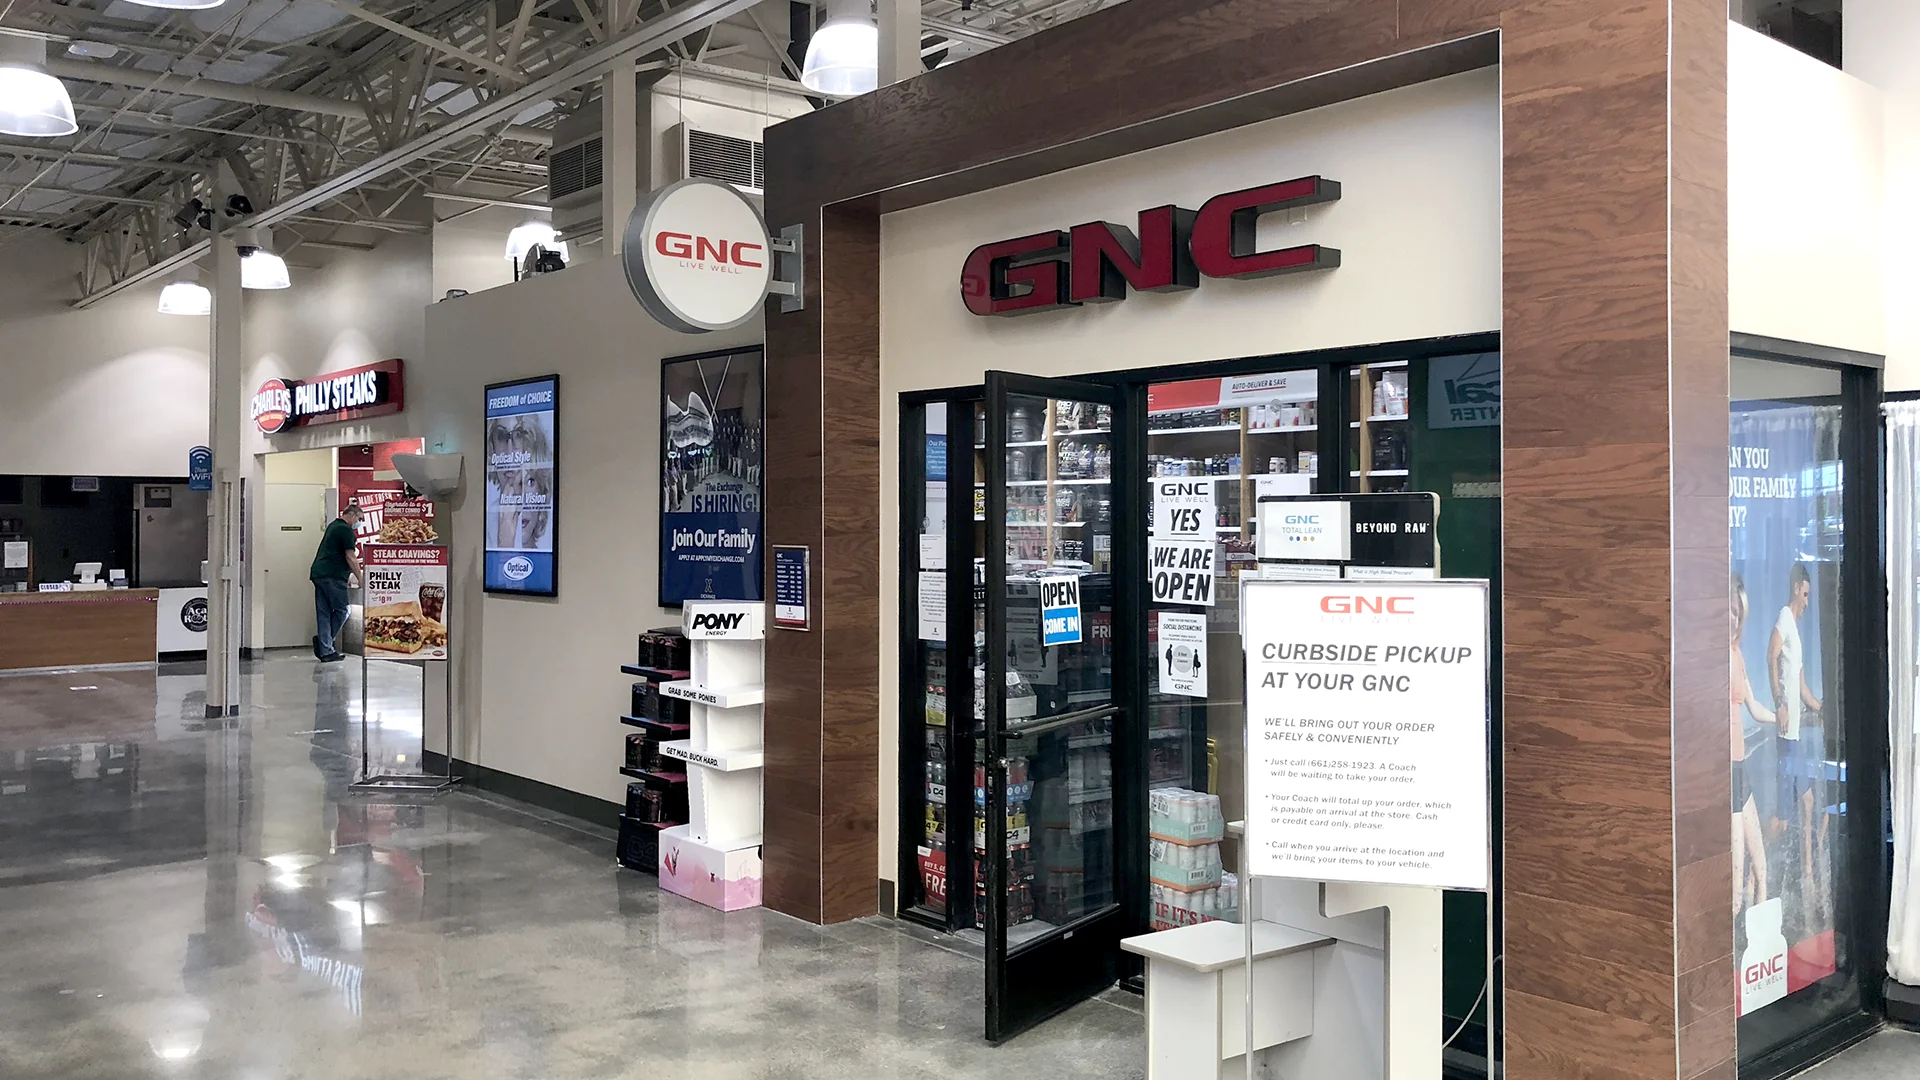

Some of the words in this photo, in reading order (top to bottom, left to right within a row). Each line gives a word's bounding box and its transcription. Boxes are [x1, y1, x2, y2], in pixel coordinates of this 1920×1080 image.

[656, 231, 762, 268] GNC
[961, 175, 1337, 317] GNC
[680, 261, 704, 270] LIVE
[1232, 381, 1268, 389] AUTO-DELIVER
[1273, 378, 1287, 386] SAVE
[295, 379, 332, 415] PHILLY
[332, 370, 376, 410] STEAKS
[489, 395, 519, 409] FREEDOM
[520, 395, 526, 404] of
[527, 391, 552, 404] CHOICE
[492, 452, 513, 465] Optical
[515, 451, 531, 464] Style
[1744, 447, 1769, 469] YOU
[191, 472, 212, 481] WiFi
[706, 483, 716, 491] The
[717, 482, 743, 493] Exchange
[1161, 483, 1208, 496] GNC
[1753, 477, 1796, 498] FAMILY
[358, 495, 374, 505] MADE
[500, 493, 524, 504] Natural
[526, 493, 546, 504] Vision
[692, 495, 702, 512] IS
[705, 494, 757, 512] HIRING!
[422, 503, 434, 517] $1
[1171, 508, 1201, 531] YES
[1285, 515, 1319, 524] GNC
[1356, 523, 1397, 533] BEYOND
[1404, 523, 1426, 533] RAW
[671, 528, 693, 551] Join
[695, 529, 716, 547] Our
[718, 528, 755, 554] Family
[373, 550, 397, 558] STEAK
[398, 550, 440, 559] CRAVINGS?
[1154, 547, 1178, 568] WE
[1178, 548, 1213, 569] ARE
[507, 563, 529, 573] Optical
[369, 572, 402, 580] PHILLY
[369, 581, 401, 590] STEAK
[1154, 572, 1211, 601] OPEN
[1043, 581, 1077, 607] OPEN
[1320, 596, 1414, 614] GNC
[692, 613, 745, 629] PONY
[1045, 617, 1066, 634] COME
[1067, 616, 1078, 632] IN
[1262, 643, 1378, 662] CURBSIDE
[1384, 646, 1472, 664] PICKUP
[1261, 672, 1288, 688] AT
[1295, 673, 1354, 691] YOUR
[1362, 675, 1410, 692] GNC
[668, 687, 681, 696] GRAB
[683, 690, 696, 699] SOME
[698, 693, 717, 704] PONIES
[1265, 718, 1296, 727] WE'LL
[1299, 719, 1334, 729] BRING
[1338, 720, 1359, 730] OUT
[1363, 721, 1392, 731] YOUR
[1396, 723, 1435, 732] ORDER
[1264, 732, 1303, 742] SAFELY
[1306, 733, 1314, 742] &
[1318, 733, 1399, 745] CONVENIENTLY
[666, 746, 676, 755] GET
[677, 749, 689, 760] MAD.
[689, 753, 703, 763] BUCK
[703, 756, 719, 767] HARD.
[1389, 763, 1416, 771] Coach
[1301, 772, 1332, 780] waiting
[933, 787, 944, 796] C4
[1271, 793, 1289, 801] Your
[1292, 794, 1318, 802] Coach
[1339, 797, 1359, 805] total
[1280, 806, 1313, 814] payable
[1416, 812, 1438, 820] Cash
[1006, 831, 1019, 839] C4
[1290, 842, 1313, 850] when
[1333, 845, 1358, 853] arrive
[1389, 848, 1425, 856] location
[1294, 854, 1315, 863] bring
[1339, 857, 1363, 865] items
[1399, 861, 1432, 869] vehicle.
[1155, 901, 1169, 918] IF
[1172, 905, 1197, 925] IT'S
[1745, 953, 1783, 985] GNC
[1745, 981, 1762, 995] LIVE
[1766, 974, 1783, 987] WELL
